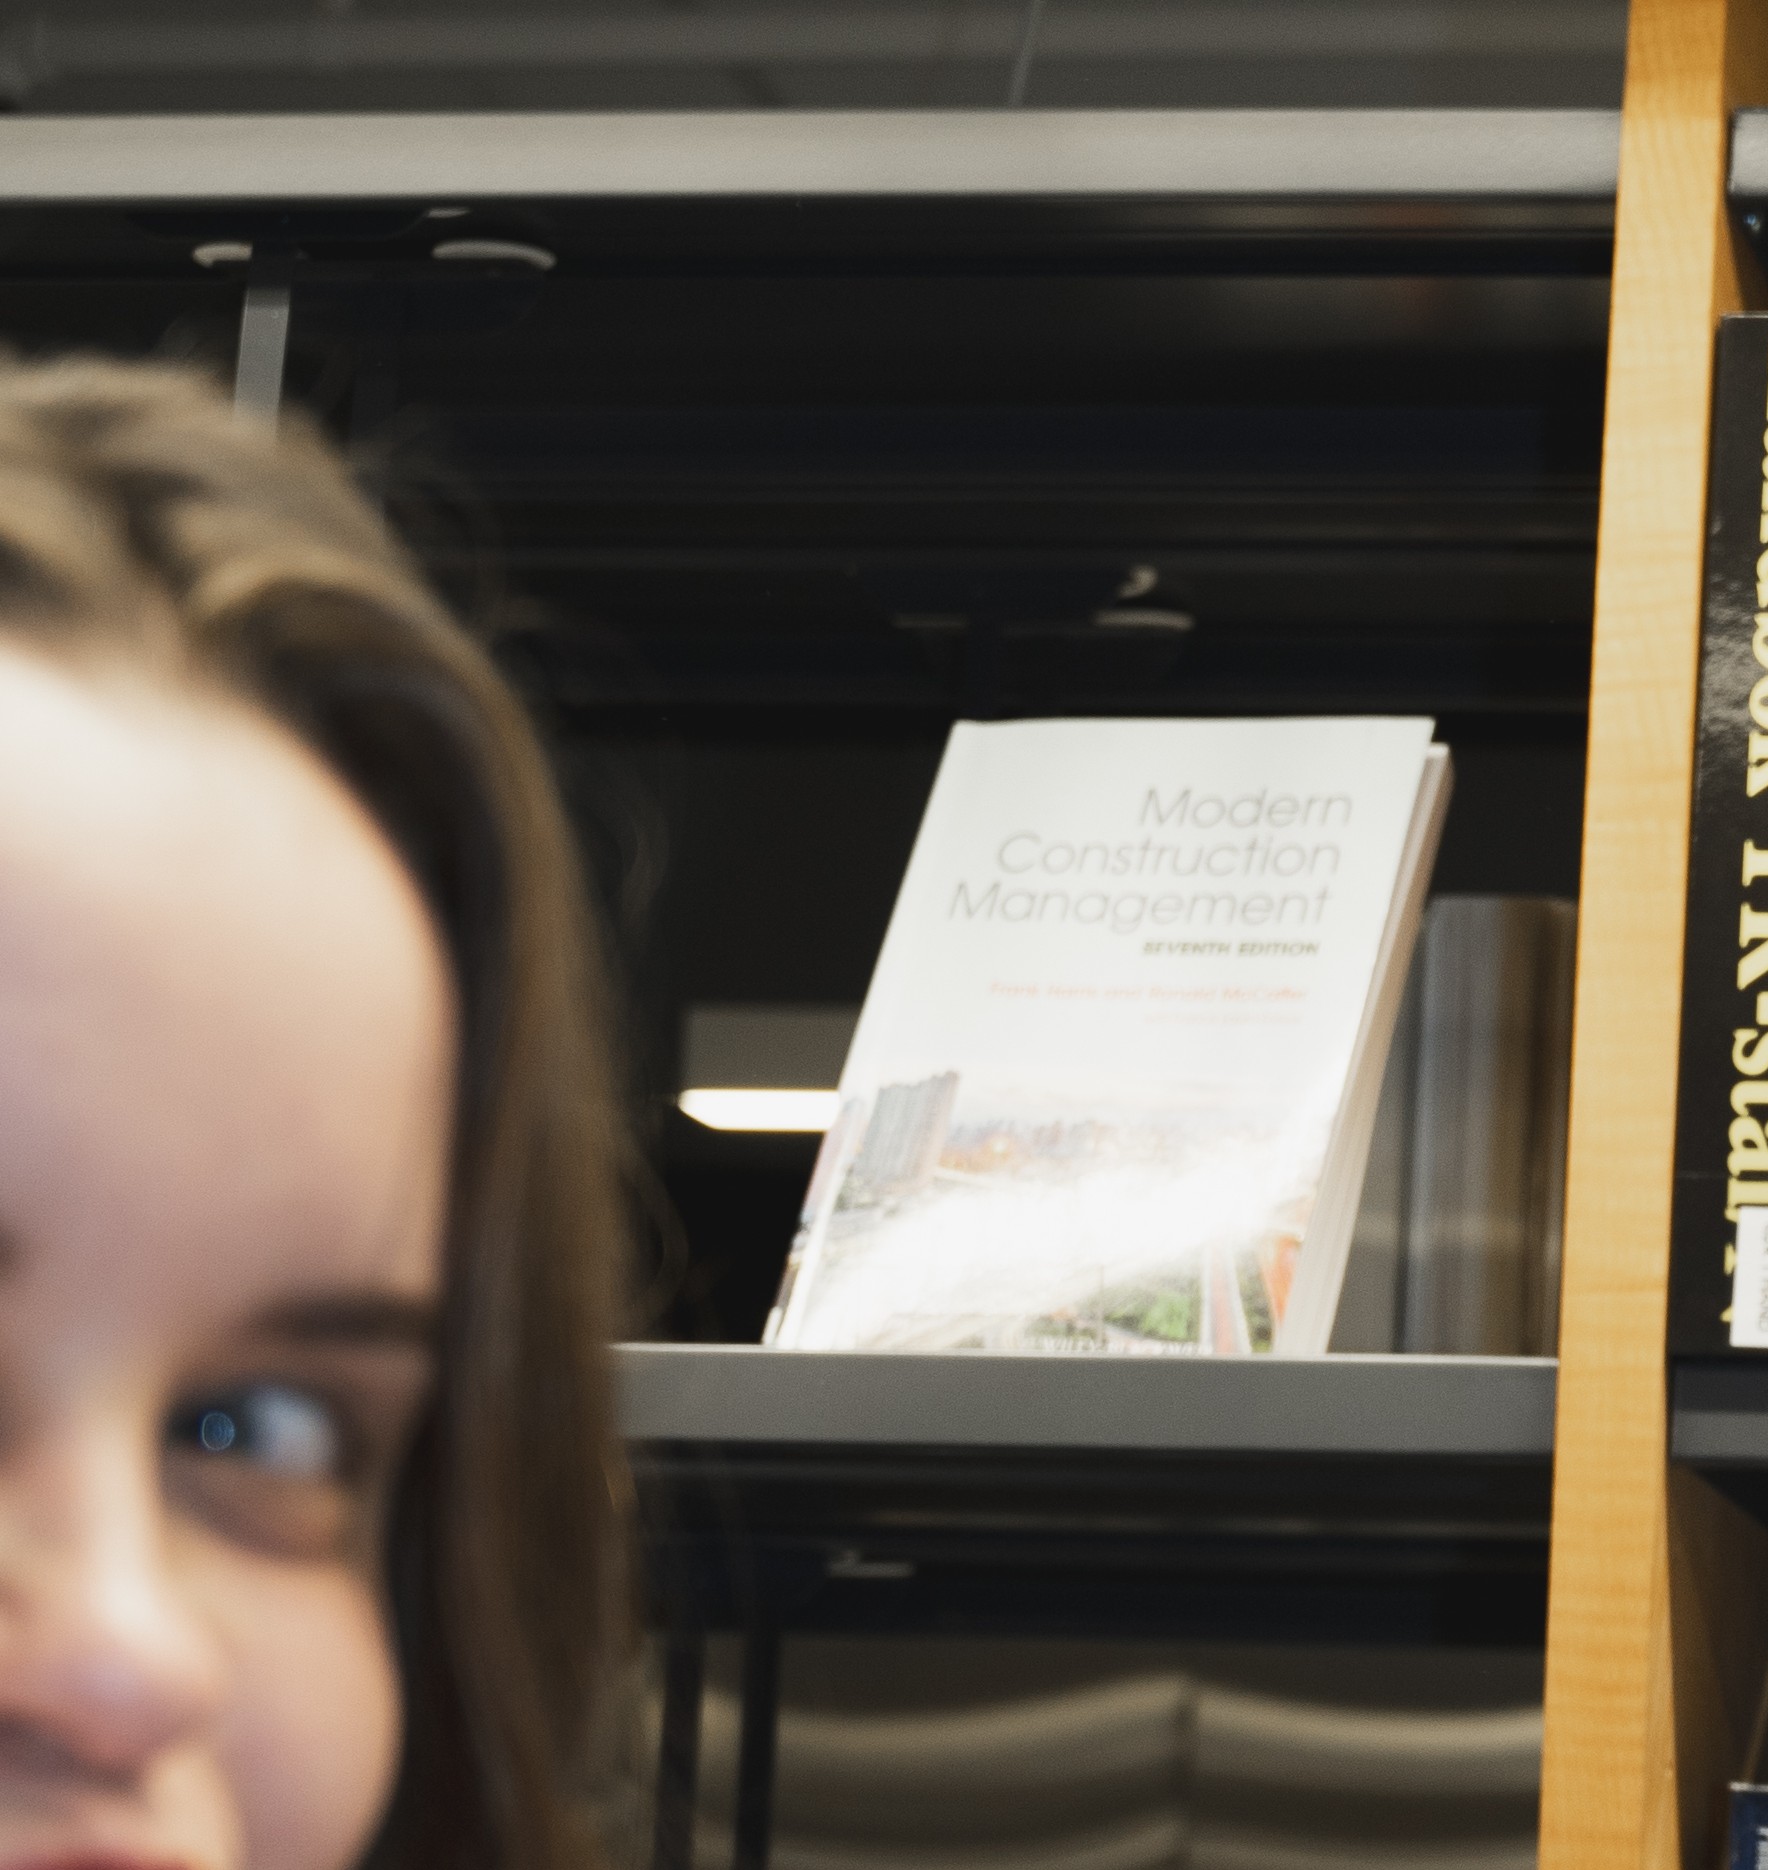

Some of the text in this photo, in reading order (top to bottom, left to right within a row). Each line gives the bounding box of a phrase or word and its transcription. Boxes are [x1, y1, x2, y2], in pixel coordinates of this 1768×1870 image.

[1138, 783, 1353, 828] Modern
[994, 829, 1342, 877] Construction
[948, 879, 1328, 934] Management
[1142, 940, 1321, 959] SEVENTH EDITION
